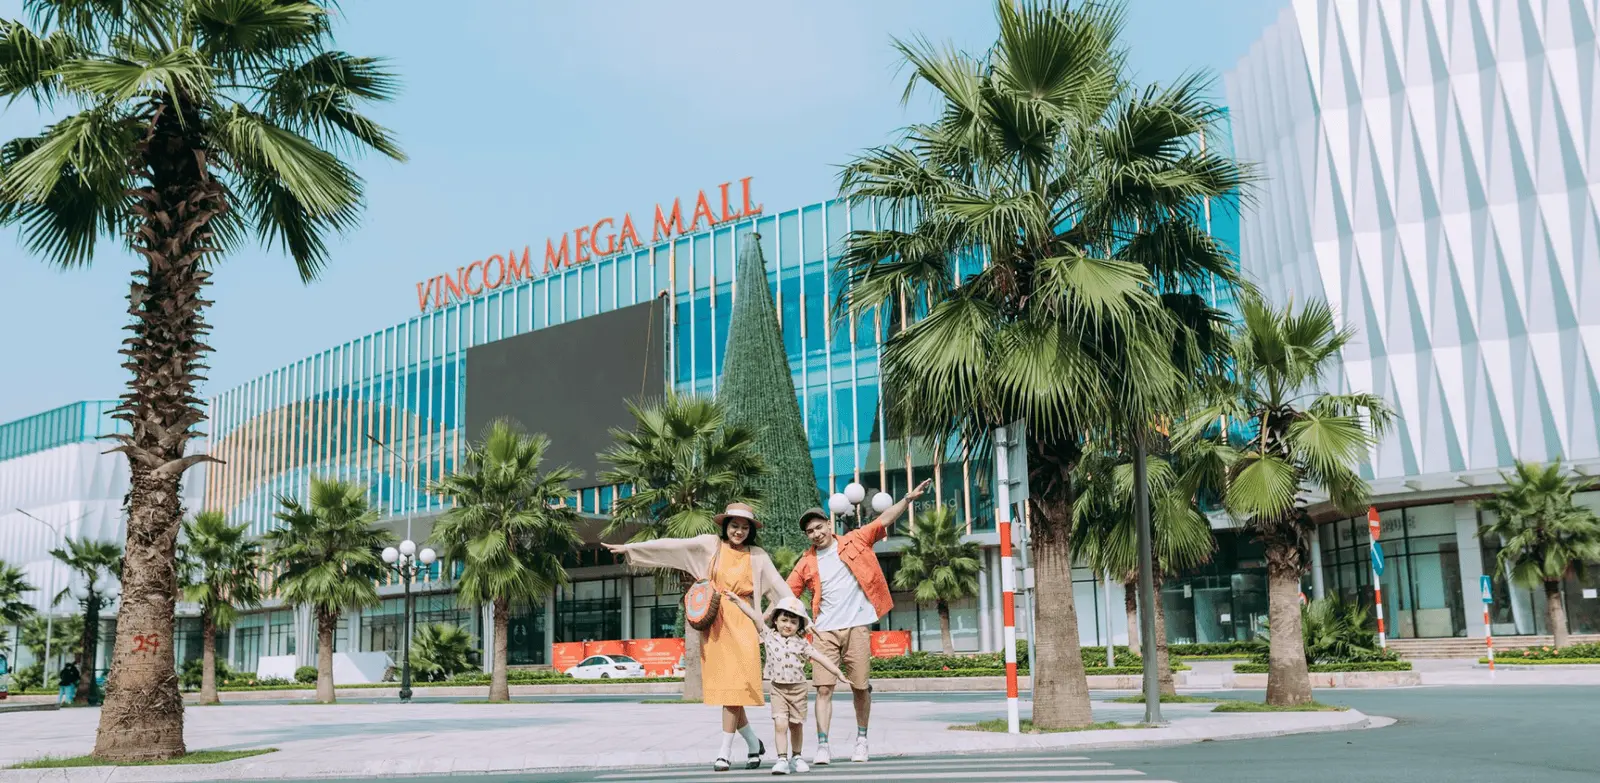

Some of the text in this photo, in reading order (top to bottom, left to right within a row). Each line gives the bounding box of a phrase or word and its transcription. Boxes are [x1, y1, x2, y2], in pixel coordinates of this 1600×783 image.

[416, 176, 763, 312] VINCOM MEGA MALL
